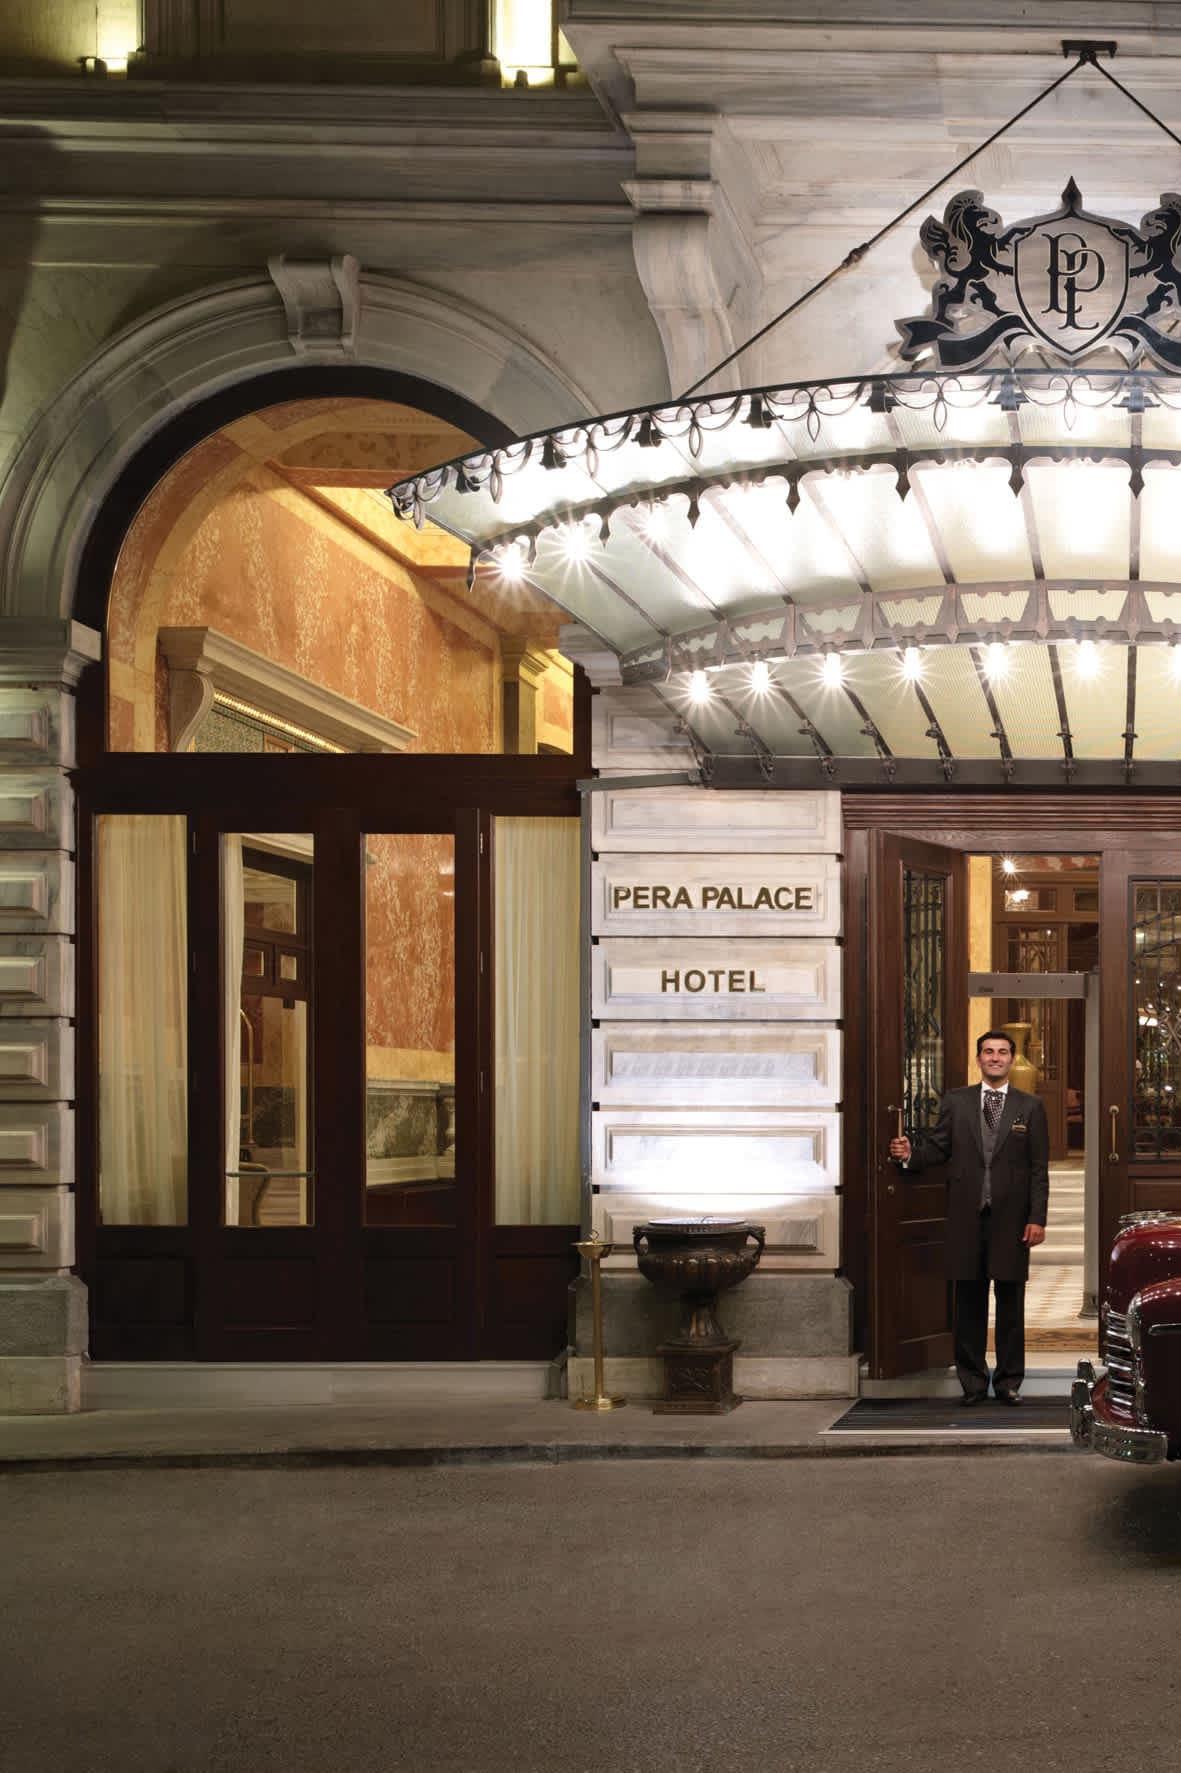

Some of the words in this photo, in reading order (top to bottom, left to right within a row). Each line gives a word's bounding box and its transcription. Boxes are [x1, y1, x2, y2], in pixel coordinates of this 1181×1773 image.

[613, 885, 694, 910] PERA
[701, 886, 813, 911] PALACE
[661, 969, 766, 993] HOTEL
